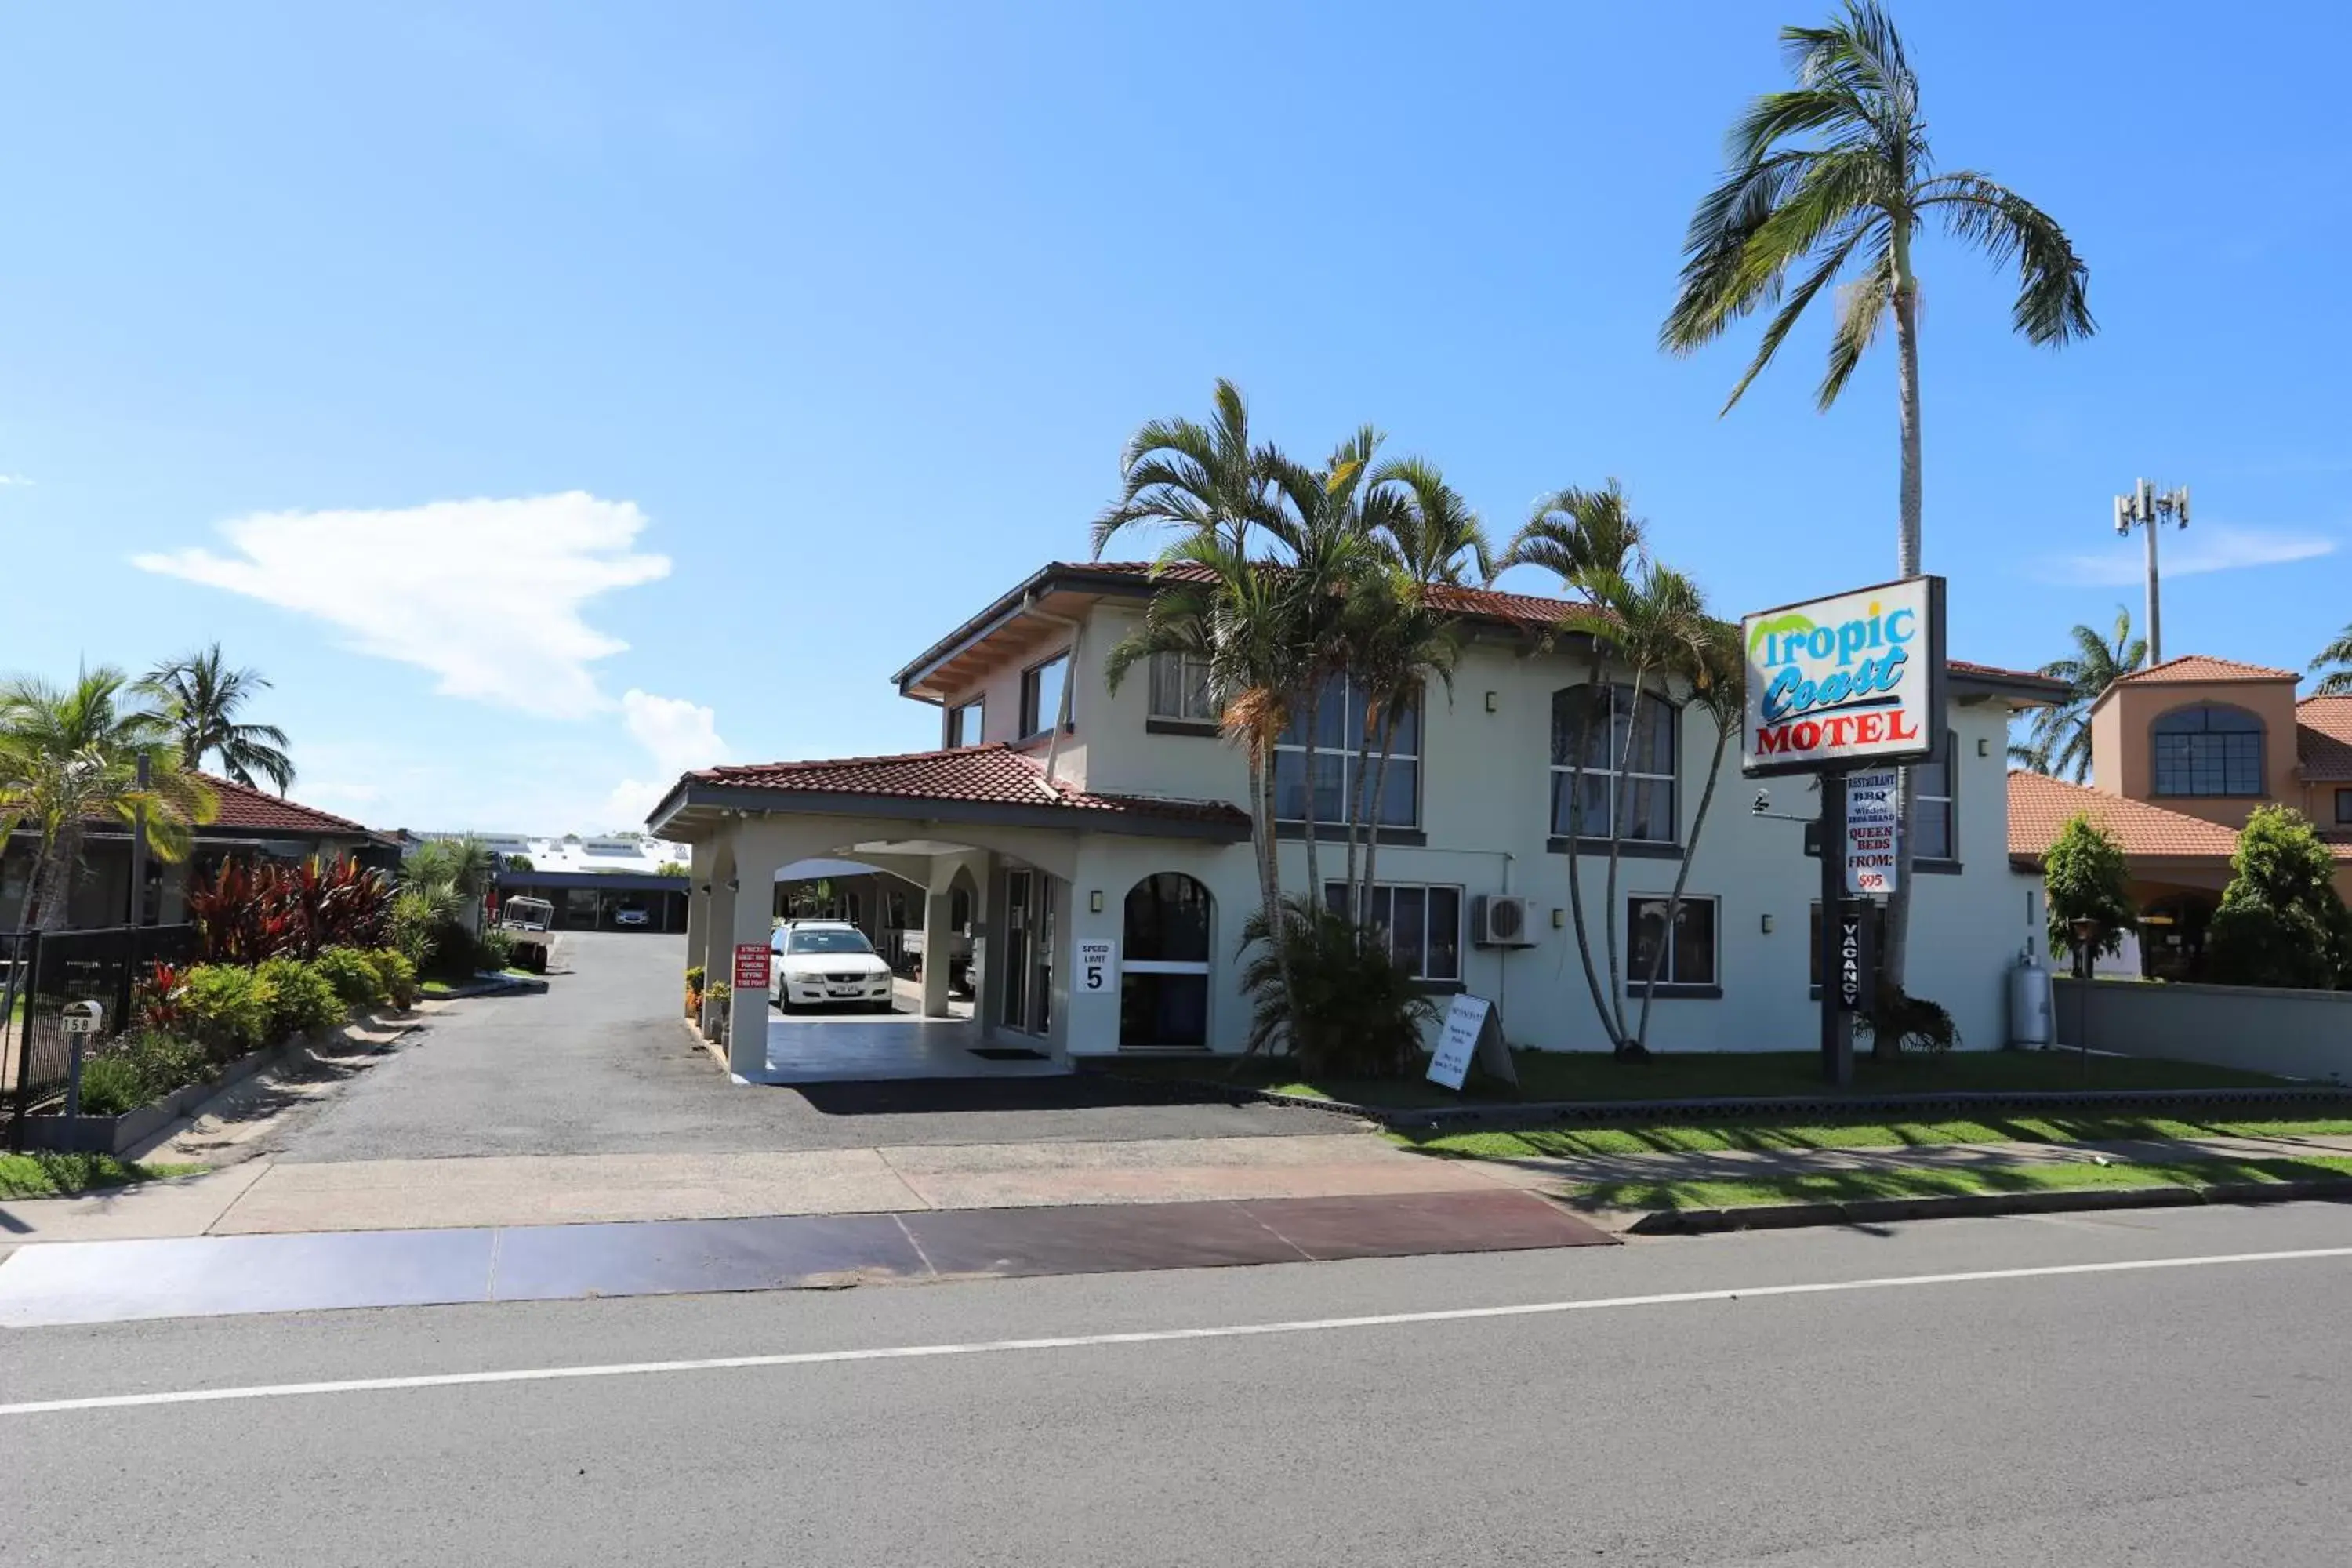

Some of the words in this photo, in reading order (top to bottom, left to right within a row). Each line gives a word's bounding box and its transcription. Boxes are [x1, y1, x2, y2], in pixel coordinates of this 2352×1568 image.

[1761, 646, 1909, 722] Coast
[1755, 710, 1918, 756] MOTEL
[1853, 791, 1886, 801] BBQ
[1849, 826, 1893, 840] QUEEN
[1857, 838, 1891, 851] BEDS
[1849, 854, 1893, 868] FROM:
[1859, 873, 1882, 887] $95
[1842, 924, 1857, 1004] VACANCY
[1087, 967, 1102, 989] 5
[64, 1019, 89, 1031] 158
